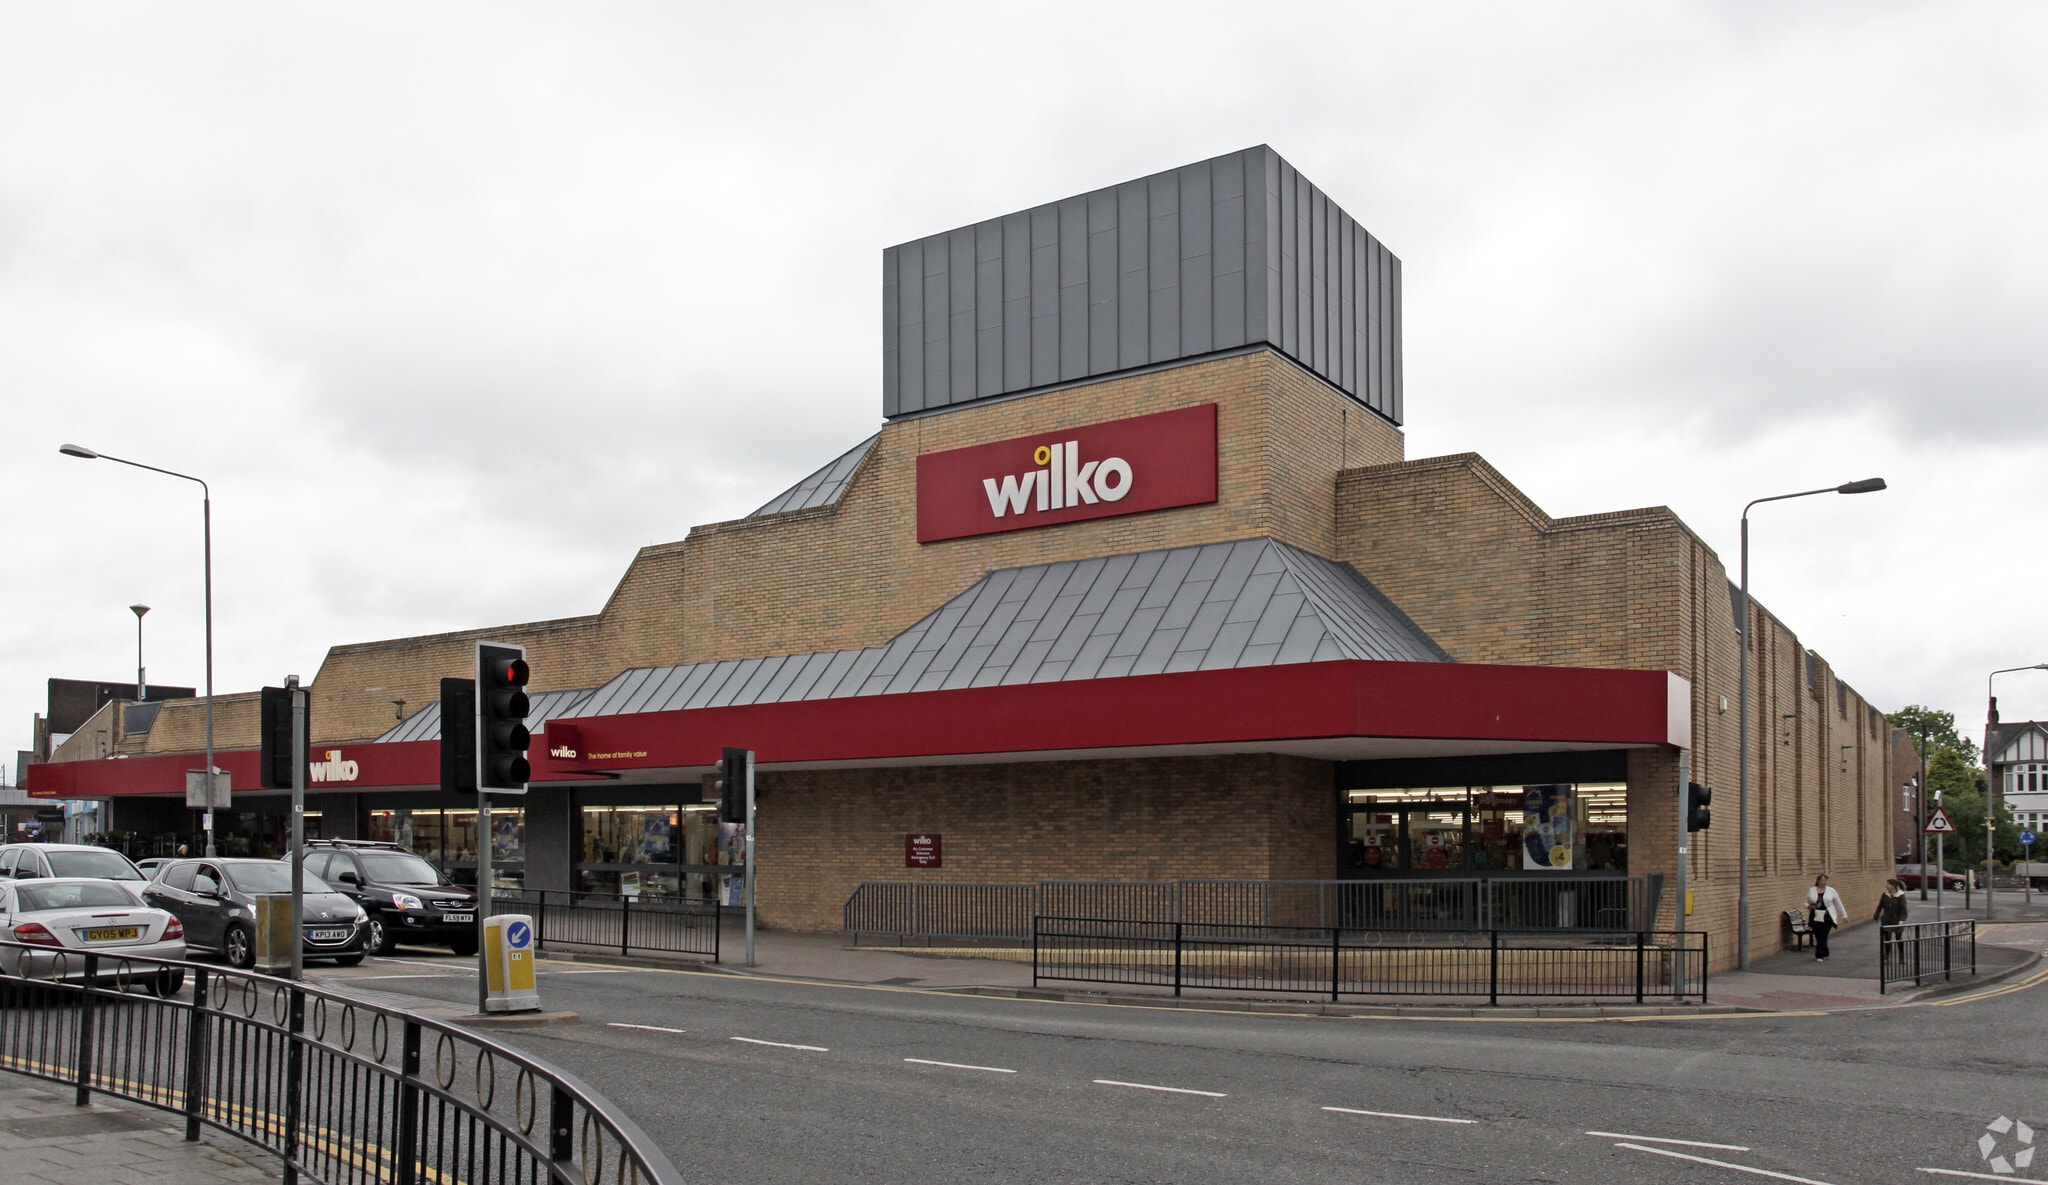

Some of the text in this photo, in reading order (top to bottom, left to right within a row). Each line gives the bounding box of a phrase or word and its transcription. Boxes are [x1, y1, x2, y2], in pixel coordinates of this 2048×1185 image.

[983, 440, 1133, 518] wilko
[550, 745, 577, 759] wilko
[588, 752, 597, 760] The
[597, 752, 611, 760] home
[618, 751, 633, 759] family
[310, 750, 359, 782] wilko
[913, 836, 931, 844] wilko
[89, 929, 138, 940] GY05 WPJ
